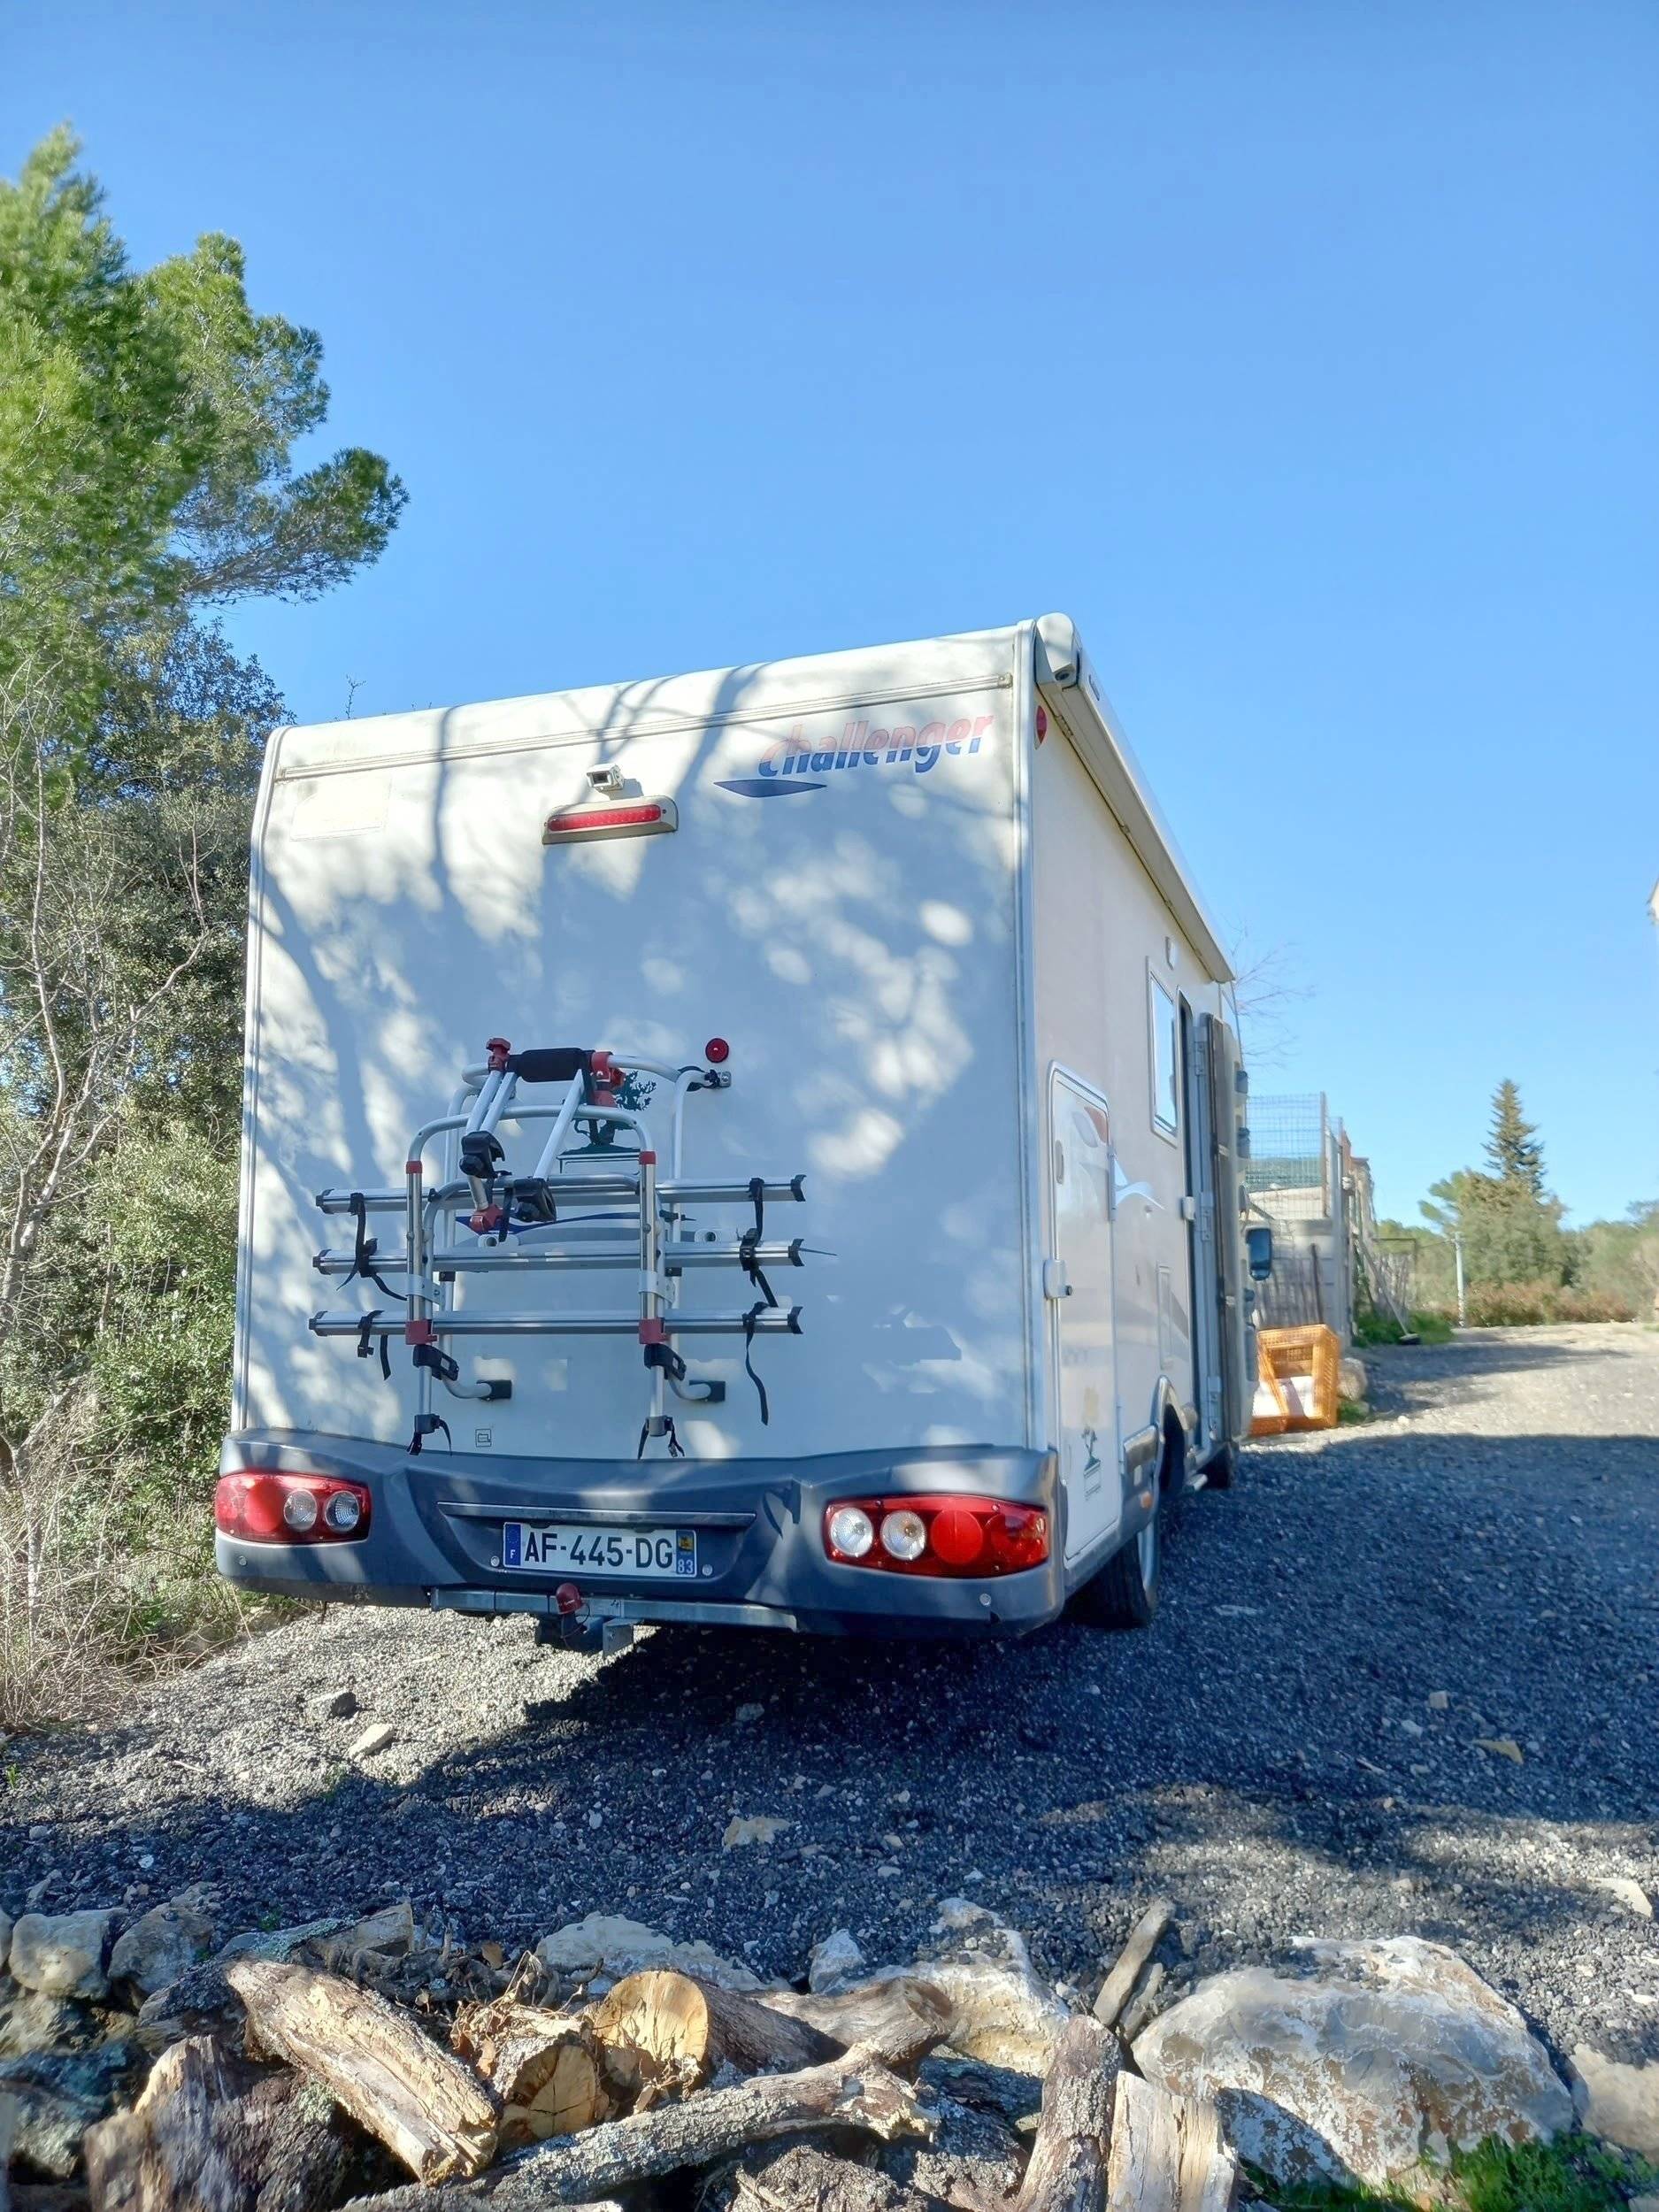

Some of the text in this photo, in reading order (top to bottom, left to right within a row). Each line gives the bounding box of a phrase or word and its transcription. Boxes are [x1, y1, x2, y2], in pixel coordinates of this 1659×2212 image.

[758, 715, 994, 777] Challenger
[510, 1549, 516, 1559] F
[525, 1532, 672, 1569] AF-445-DG
[678, 1558, 694, 1574] 83
